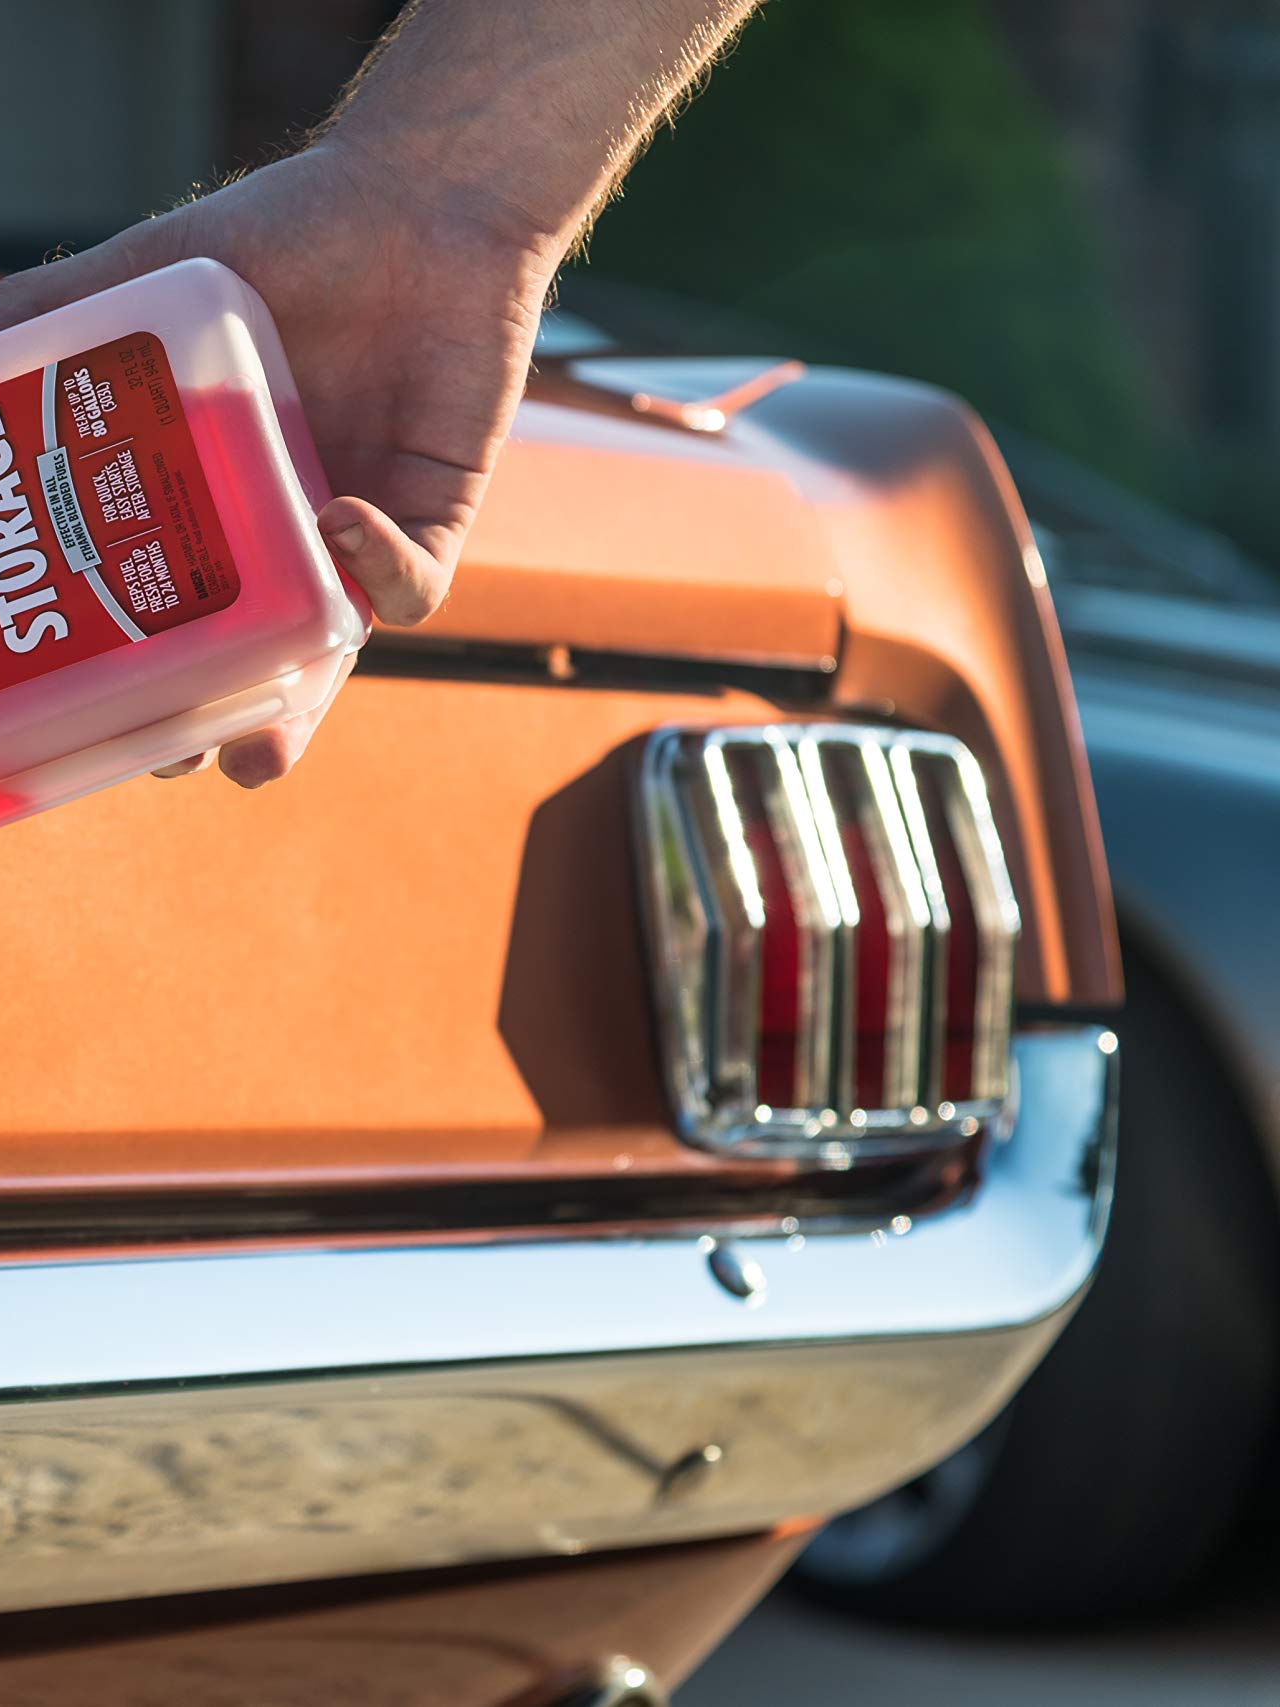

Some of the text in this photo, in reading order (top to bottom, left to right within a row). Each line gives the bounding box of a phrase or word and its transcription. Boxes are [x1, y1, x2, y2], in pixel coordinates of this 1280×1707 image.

[118, 349, 144, 391] 32 FL OZ
[137, 341, 153, 358] mL
[141, 358, 159, 378] 946
[63, 378, 92, 438] TREATS UP TO
[73, 367, 108, 438] 80 GALLONS
[95, 381, 118, 412] (303L)
[147, 377, 171, 416] QUART)
[45, 475, 75, 549] EFFECTIVE IN ALL
[53, 453, 96, 562] ETHANOL BLENDED FUELS
[92, 470, 119, 523] FOR QUICK,
[105, 461, 135, 521] EASY STARTS
[117, 449, 151, 521] AFTER STORAGE
[120, 557, 148, 613] KEEPS FUEL
[131, 548, 165, 613] FRESH FOR UP
[146, 540, 180, 609] TO 24 MONTHS
